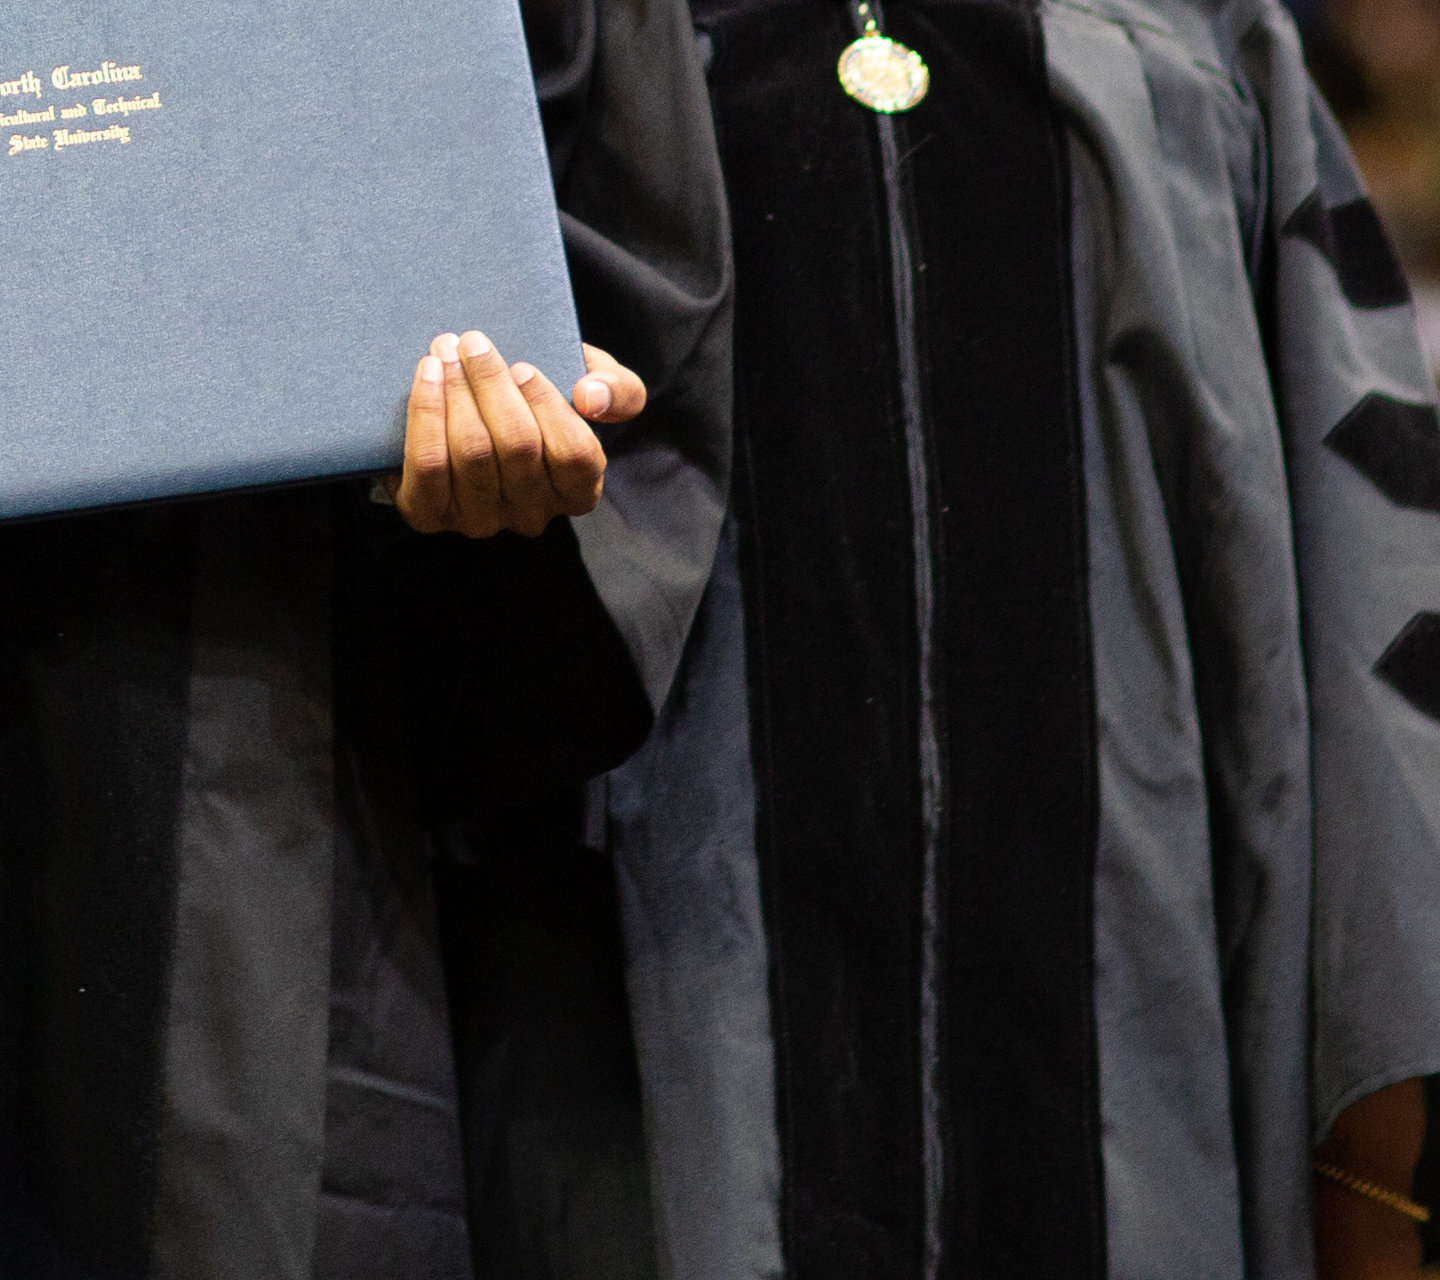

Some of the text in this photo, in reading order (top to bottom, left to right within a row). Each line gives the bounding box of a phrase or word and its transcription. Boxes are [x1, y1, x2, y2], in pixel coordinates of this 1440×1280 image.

[51, 61, 143, 90] Carolina
[60, 103, 87, 120] and
[91, 91, 162, 117] Technical
[8, 124, 132, 156] State University
